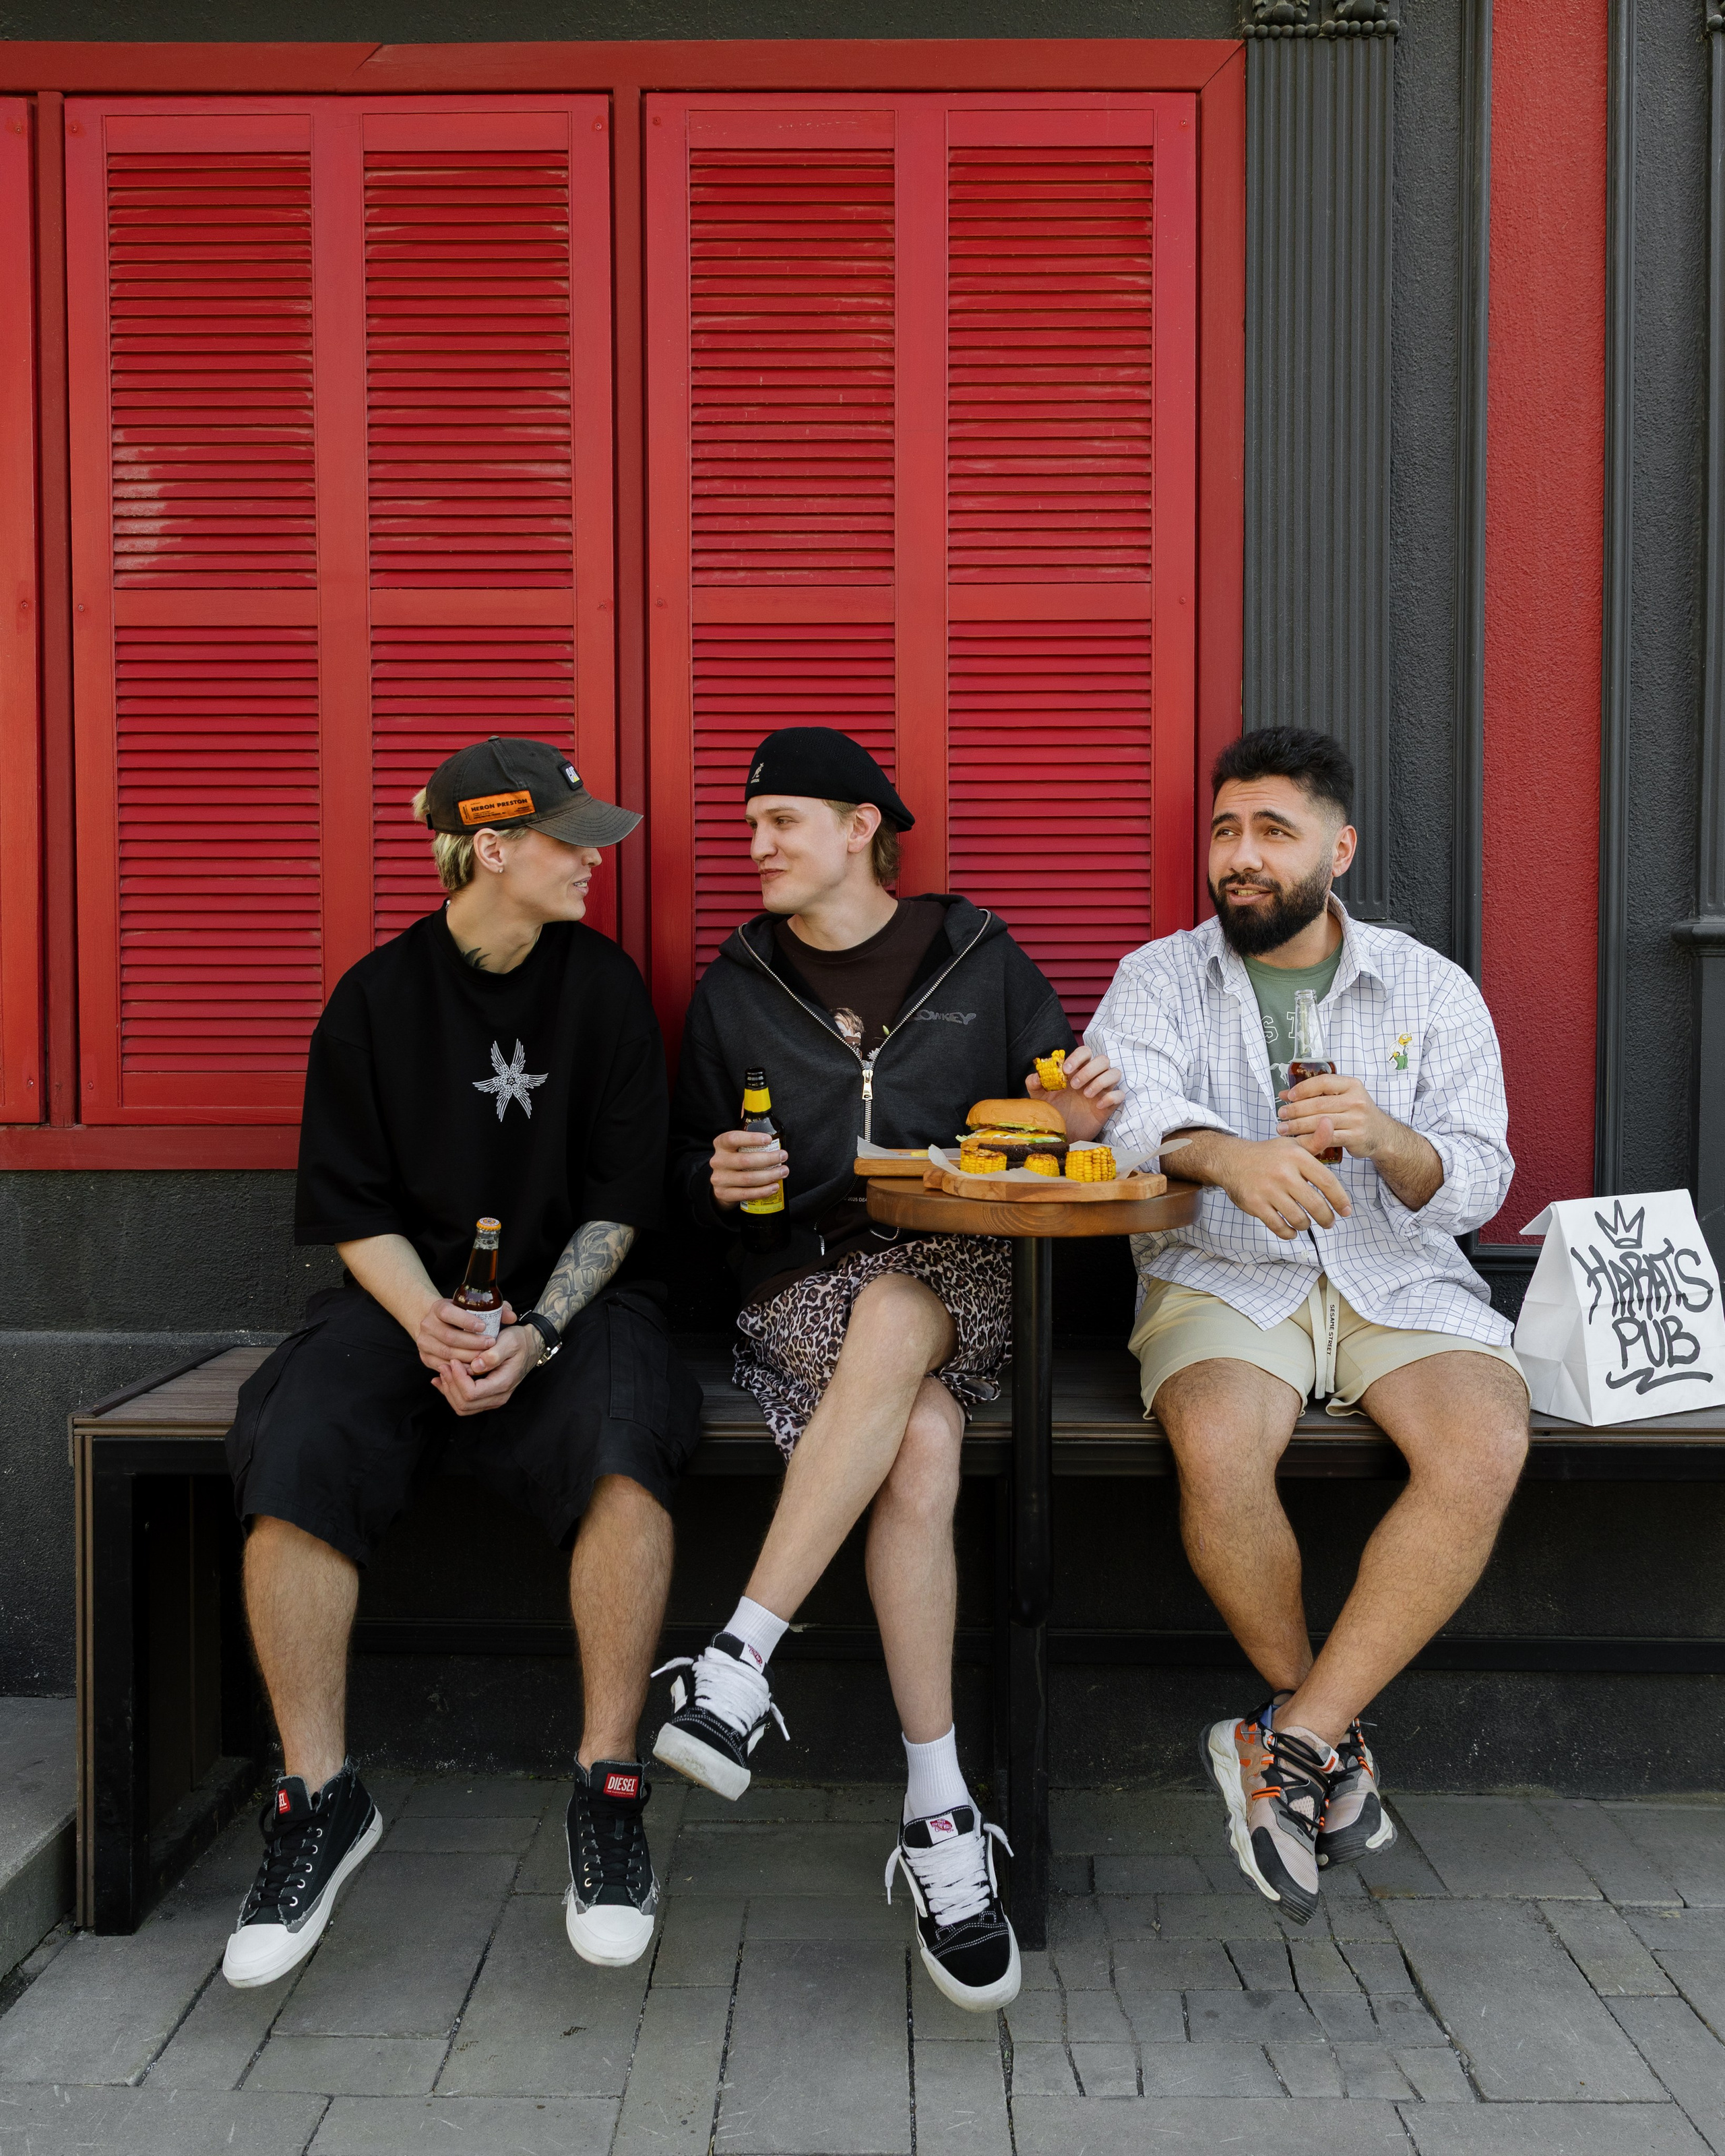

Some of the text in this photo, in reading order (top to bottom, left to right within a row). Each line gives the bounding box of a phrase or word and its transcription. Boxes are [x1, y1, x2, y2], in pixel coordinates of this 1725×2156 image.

[471, 803, 495, 812] HERON
[497, 798, 528, 808] PRESTON
[1571, 1238, 1714, 1325] HARATS
[1612, 1315, 1701, 1370] PUB
[607, 1776, 635, 1792] DIESEL
